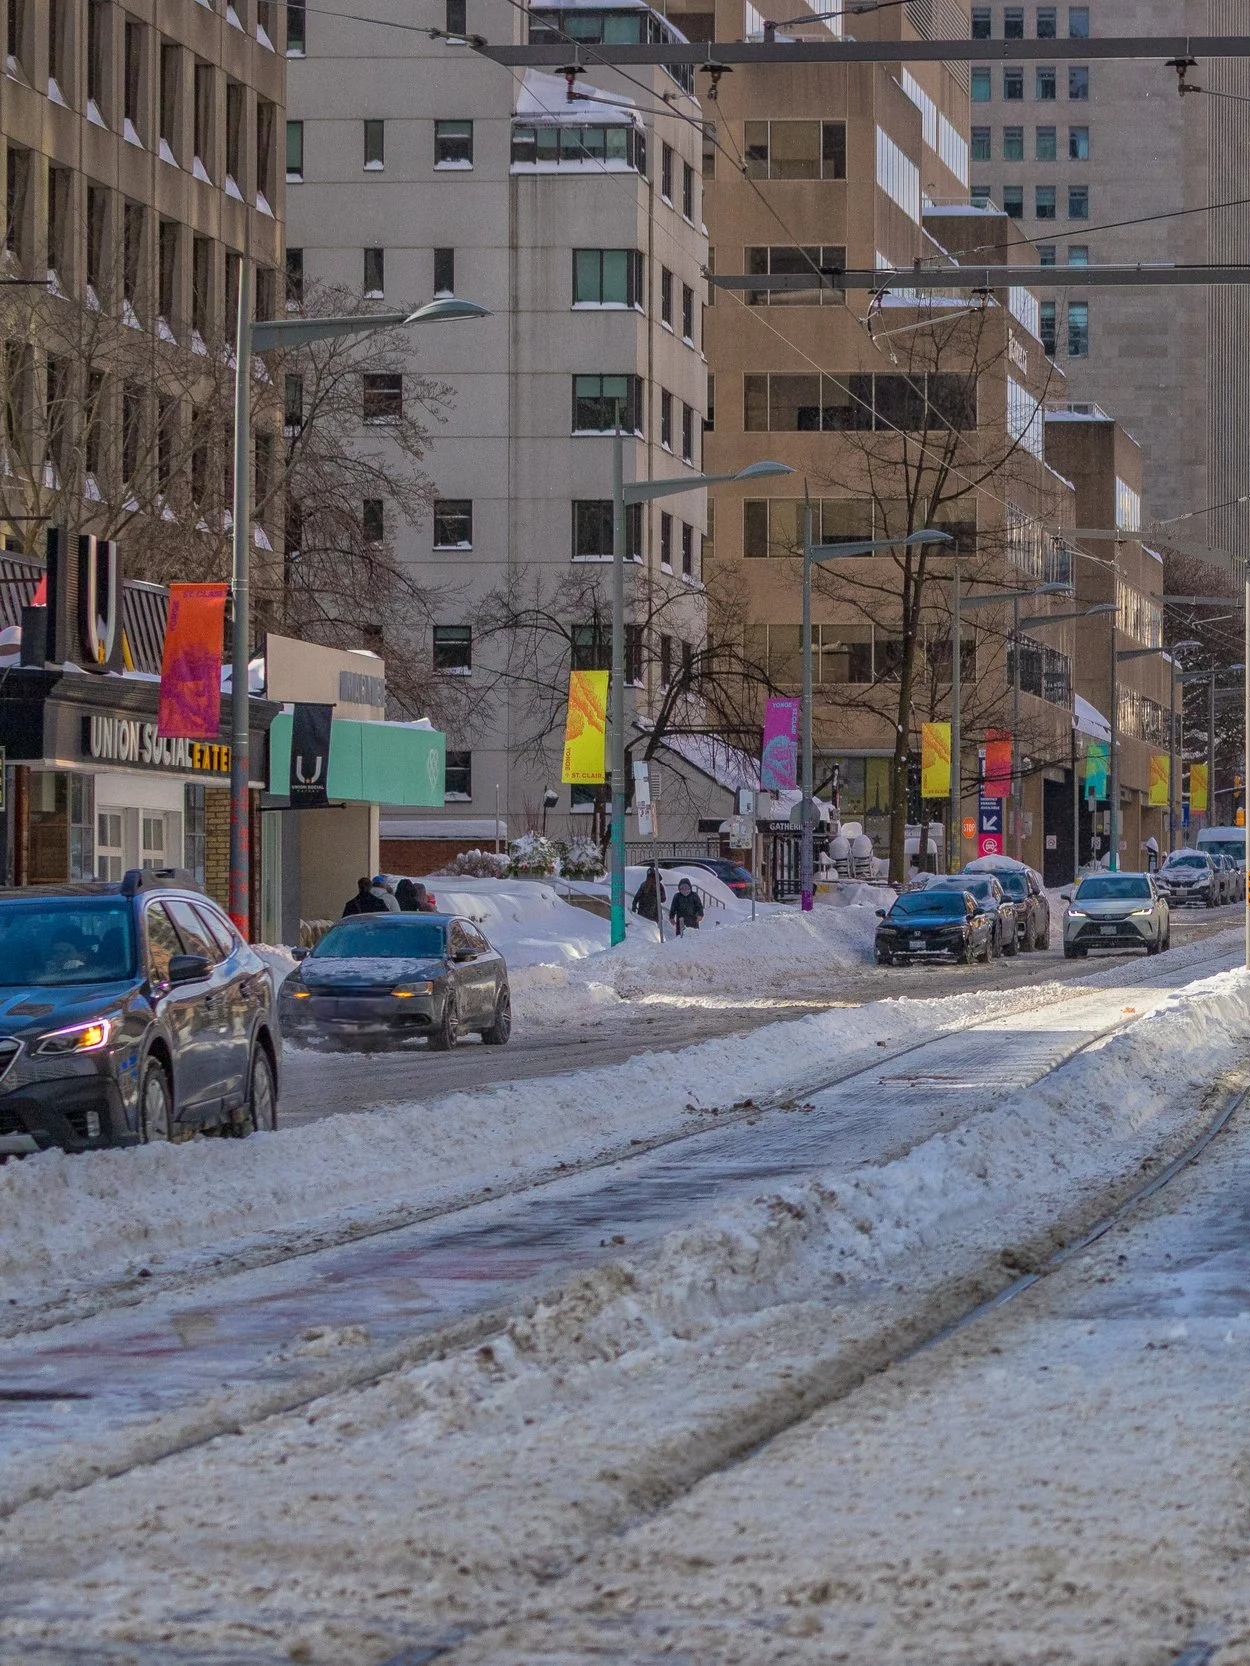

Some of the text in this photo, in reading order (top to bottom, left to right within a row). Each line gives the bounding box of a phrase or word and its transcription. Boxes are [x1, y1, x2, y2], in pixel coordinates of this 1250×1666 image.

[90, 715, 140, 762] UNION
[192, 742, 232, 773] EATE
[295, 755, 323, 784] U
[963, 823, 976, 833] STOP
